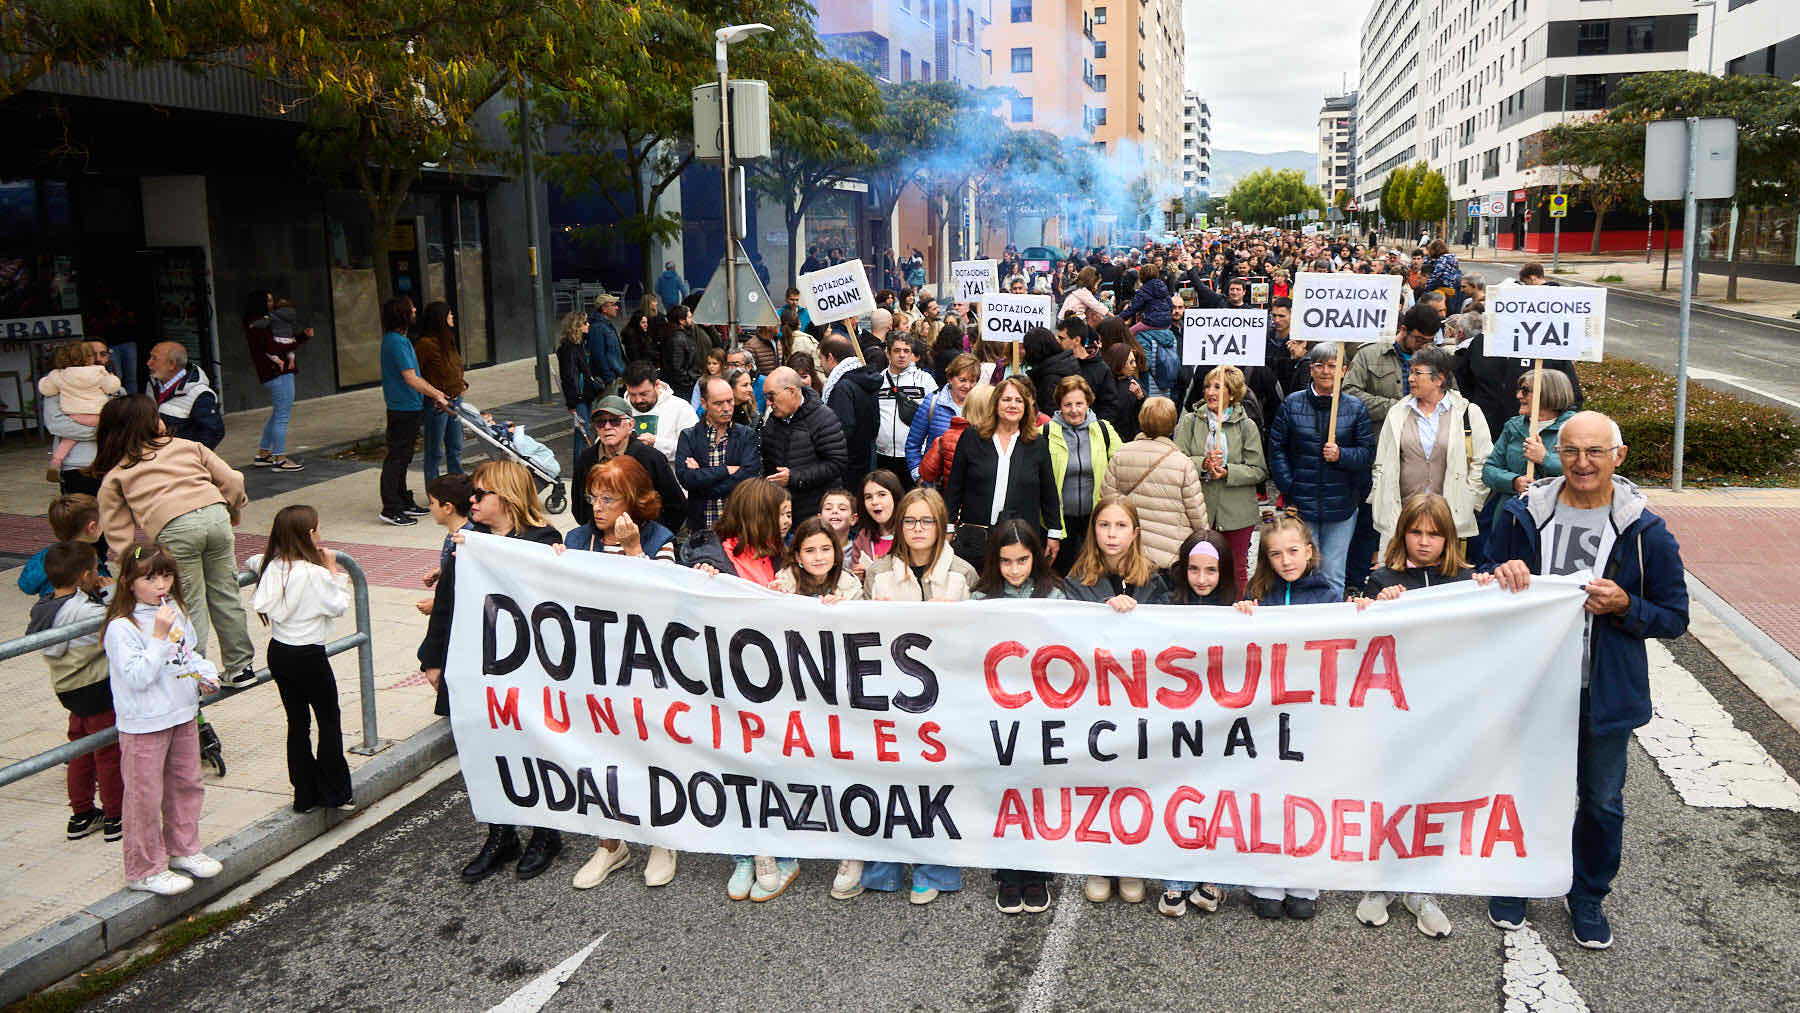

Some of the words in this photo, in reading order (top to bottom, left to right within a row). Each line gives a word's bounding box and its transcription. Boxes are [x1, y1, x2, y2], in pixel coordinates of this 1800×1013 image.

[812, 275, 855, 294] DOTAZIOAK
[963, 281, 984, 299] ¡YA!
[1305, 288, 1388, 300] DOTAZIOAK
[817, 287, 861, 311] ORAIN!
[988, 303, 1044, 314] DOTAZIOAK
[1495, 301, 1591, 314] DOTACIONES
[0, 319, 72, 338] BAB
[1186, 316, 1264, 328] DOTACIONES
[1303, 307, 1387, 329] ORAIN!
[1201, 334, 1247, 361] ¡YA!
[1513, 321, 1570, 352] ¡YA!
[482, 593, 940, 713] DOTACIONES
[984, 634, 1410, 711] CONSULTA
[486, 686, 948, 762] MUNICIPALES
[990, 713, 1305, 766] VECINAL
[495, 755, 641, 826] UDAL
[648, 765, 963, 840] DOTAZIOAK
[992, 786, 1154, 846] AUZO
[1164, 785, 1528, 863] GALDEKETA
